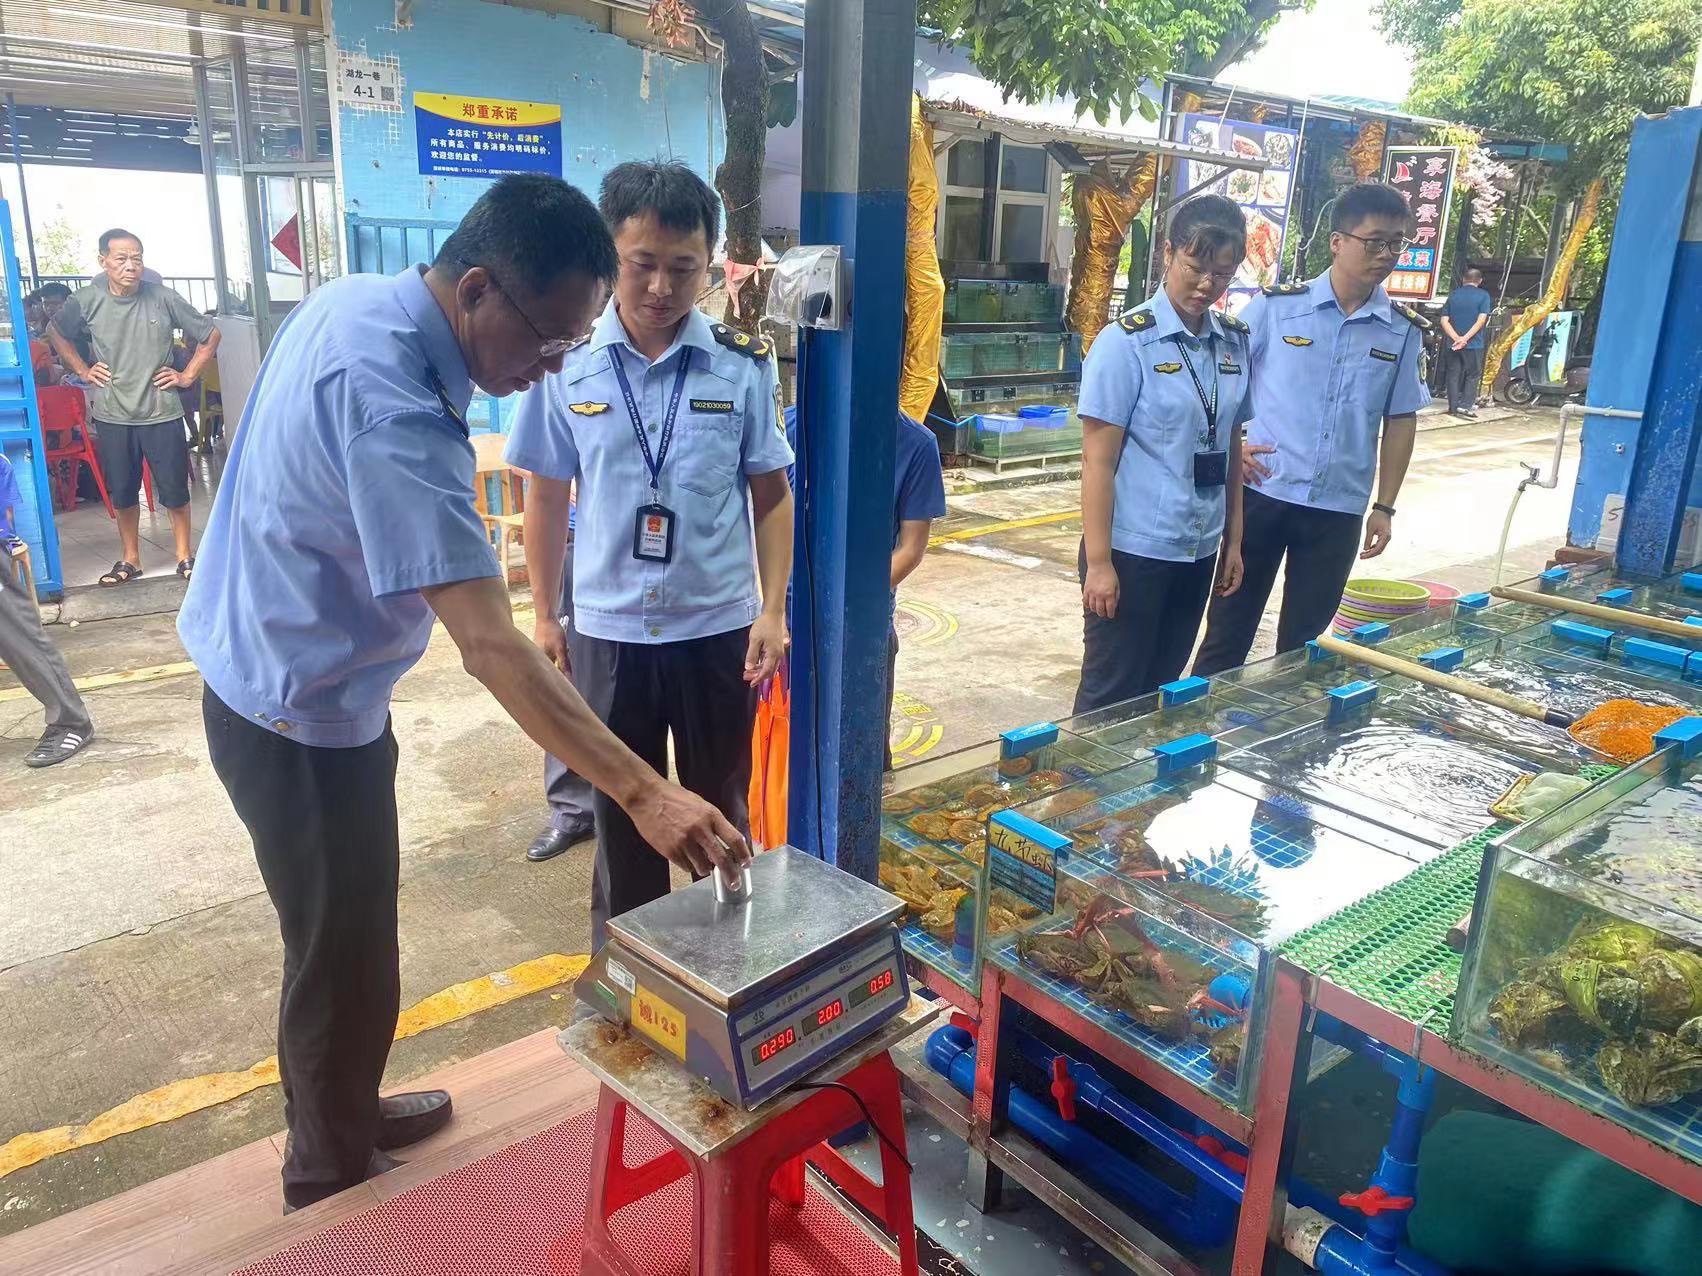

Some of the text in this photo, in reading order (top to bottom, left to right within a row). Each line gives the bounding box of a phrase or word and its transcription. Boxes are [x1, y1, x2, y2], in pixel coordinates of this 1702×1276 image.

[353, 85, 375, 98] 4-1
[462, 103, 518, 121] 郑重承诺
[869, 970, 892, 994] 0.58
[817, 1000, 842, 1025] 2.00
[760, 1029, 794, 1060] 0.290
